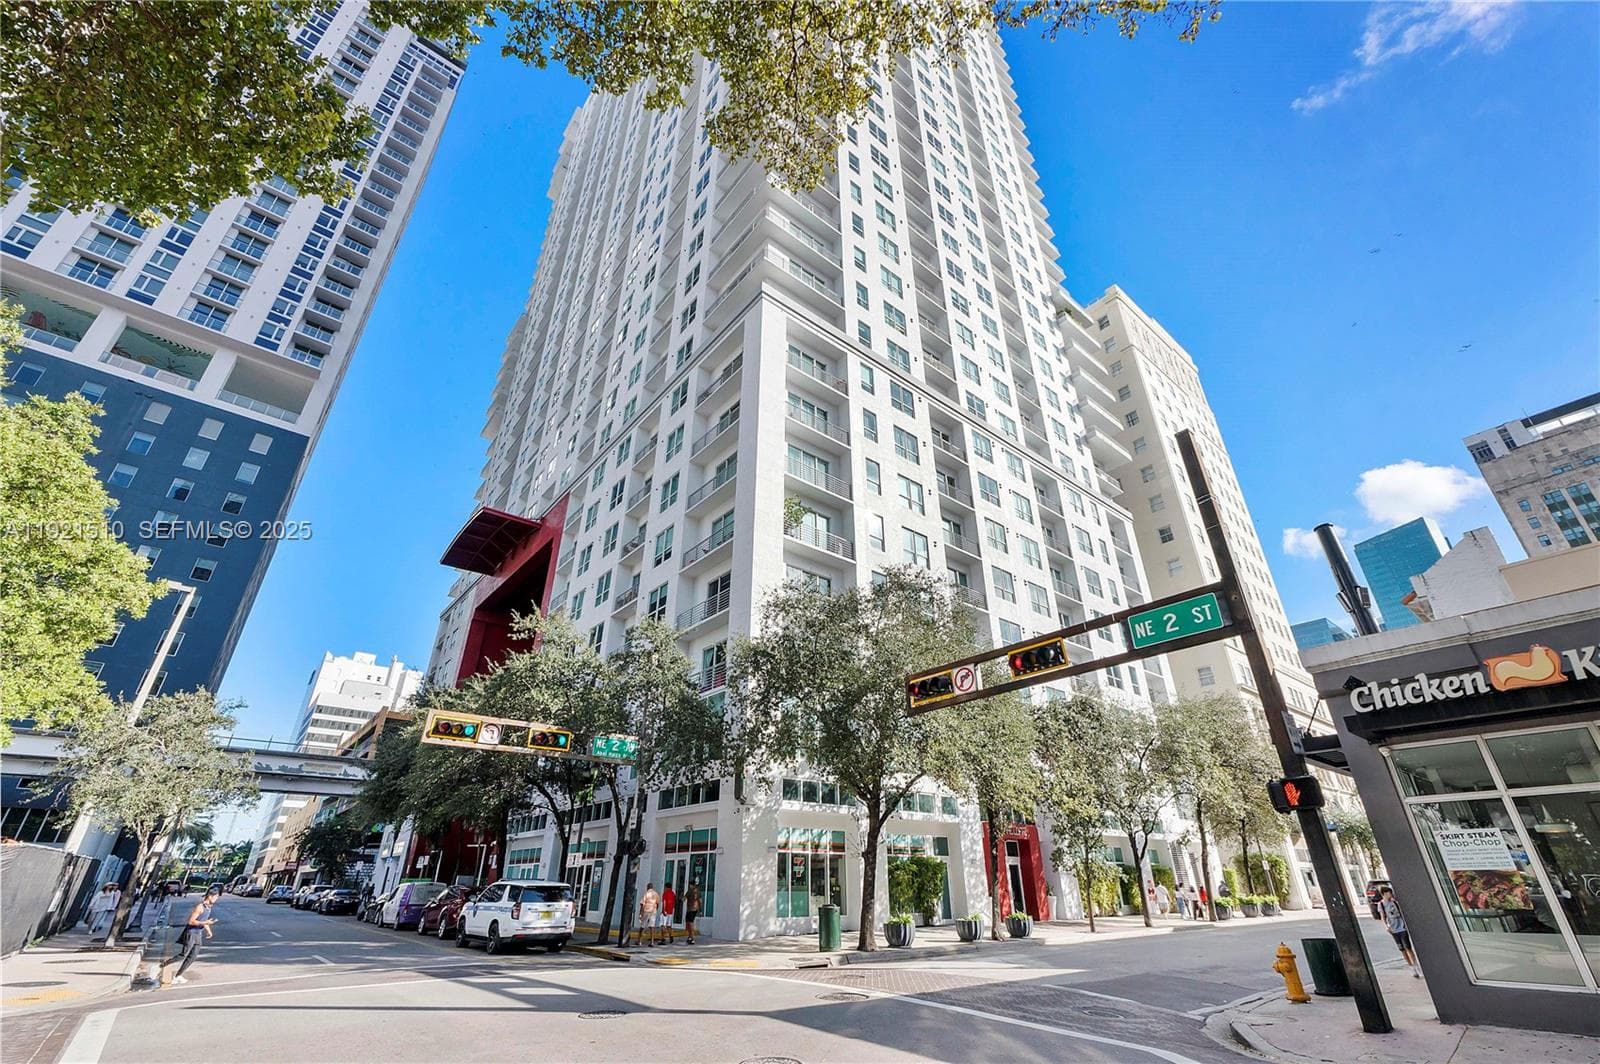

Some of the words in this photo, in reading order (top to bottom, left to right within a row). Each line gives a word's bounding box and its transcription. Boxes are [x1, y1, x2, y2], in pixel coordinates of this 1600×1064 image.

[1134, 619, 1156, 640] NE
[1162, 613, 1179, 634] 2
[1190, 603, 1213, 624] ST
[1349, 671, 1491, 714] Chicken
[595, 739, 607, 749] NE
[612, 740, 620, 751] 2
[1467, 831, 1498, 839] STEAK
[1442, 838, 1501, 848] Chop-Chop
